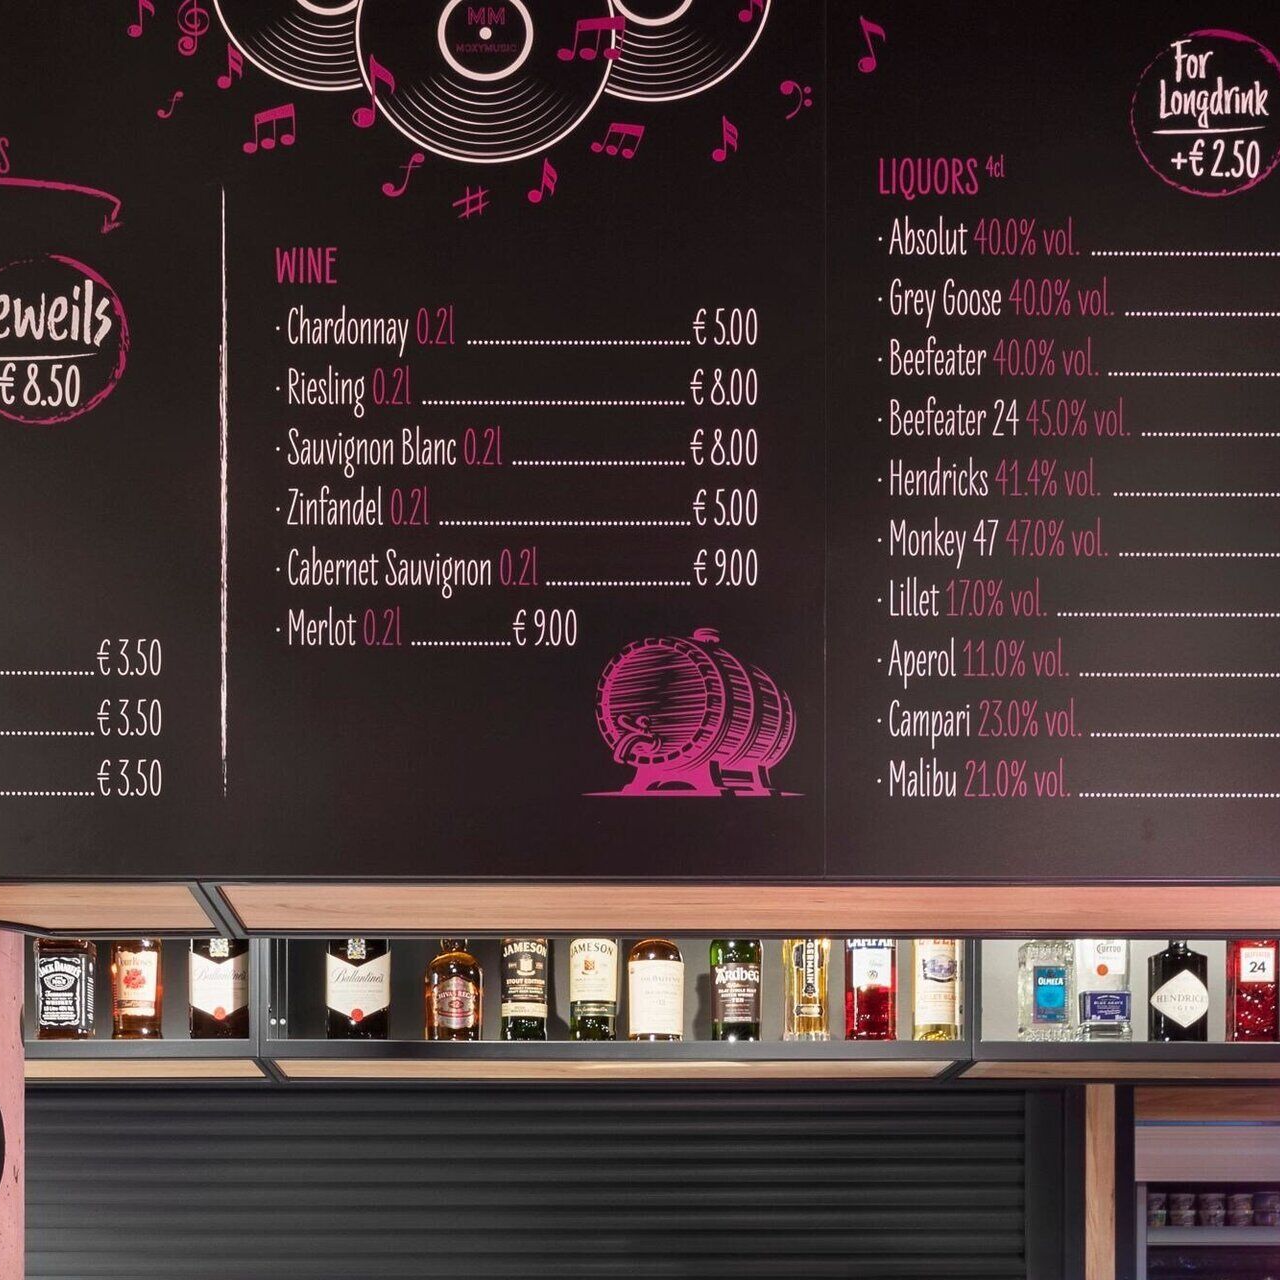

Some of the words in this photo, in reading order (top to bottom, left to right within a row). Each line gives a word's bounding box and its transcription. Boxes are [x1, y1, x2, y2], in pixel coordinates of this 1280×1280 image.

[1171, 40, 1213, 82] For
[1159, 79, 1269, 128] Longdrink
[880, 158, 978, 200] LIQUORS
[986, 155, 1005, 177] 4cl
[889, 216, 968, 255] Absolut
[974, 219, 1036, 255] 40.0%
[1043, 217, 1079, 255] vol.
[276, 248, 337, 283] WINE
[288, 305, 408, 357] Chardonnay
[714, 308, 757, 345] 5.00
[288, 546, 379, 585] Cabernet
[386, 549, 490, 598] Sauvignon
[118, 639, 161, 675] 3.50
[503, 942, 547, 957] JAMESON
[571, 942, 613, 957] JAMESON
[1249, 961, 1266, 973] 24
[39, 965, 54, 977] JACK
[54, 960, 81, 978] DANIEL'S
[330, 967, 384, 983] Ballantine's
[1038, 976, 1064, 986] OLMECA
